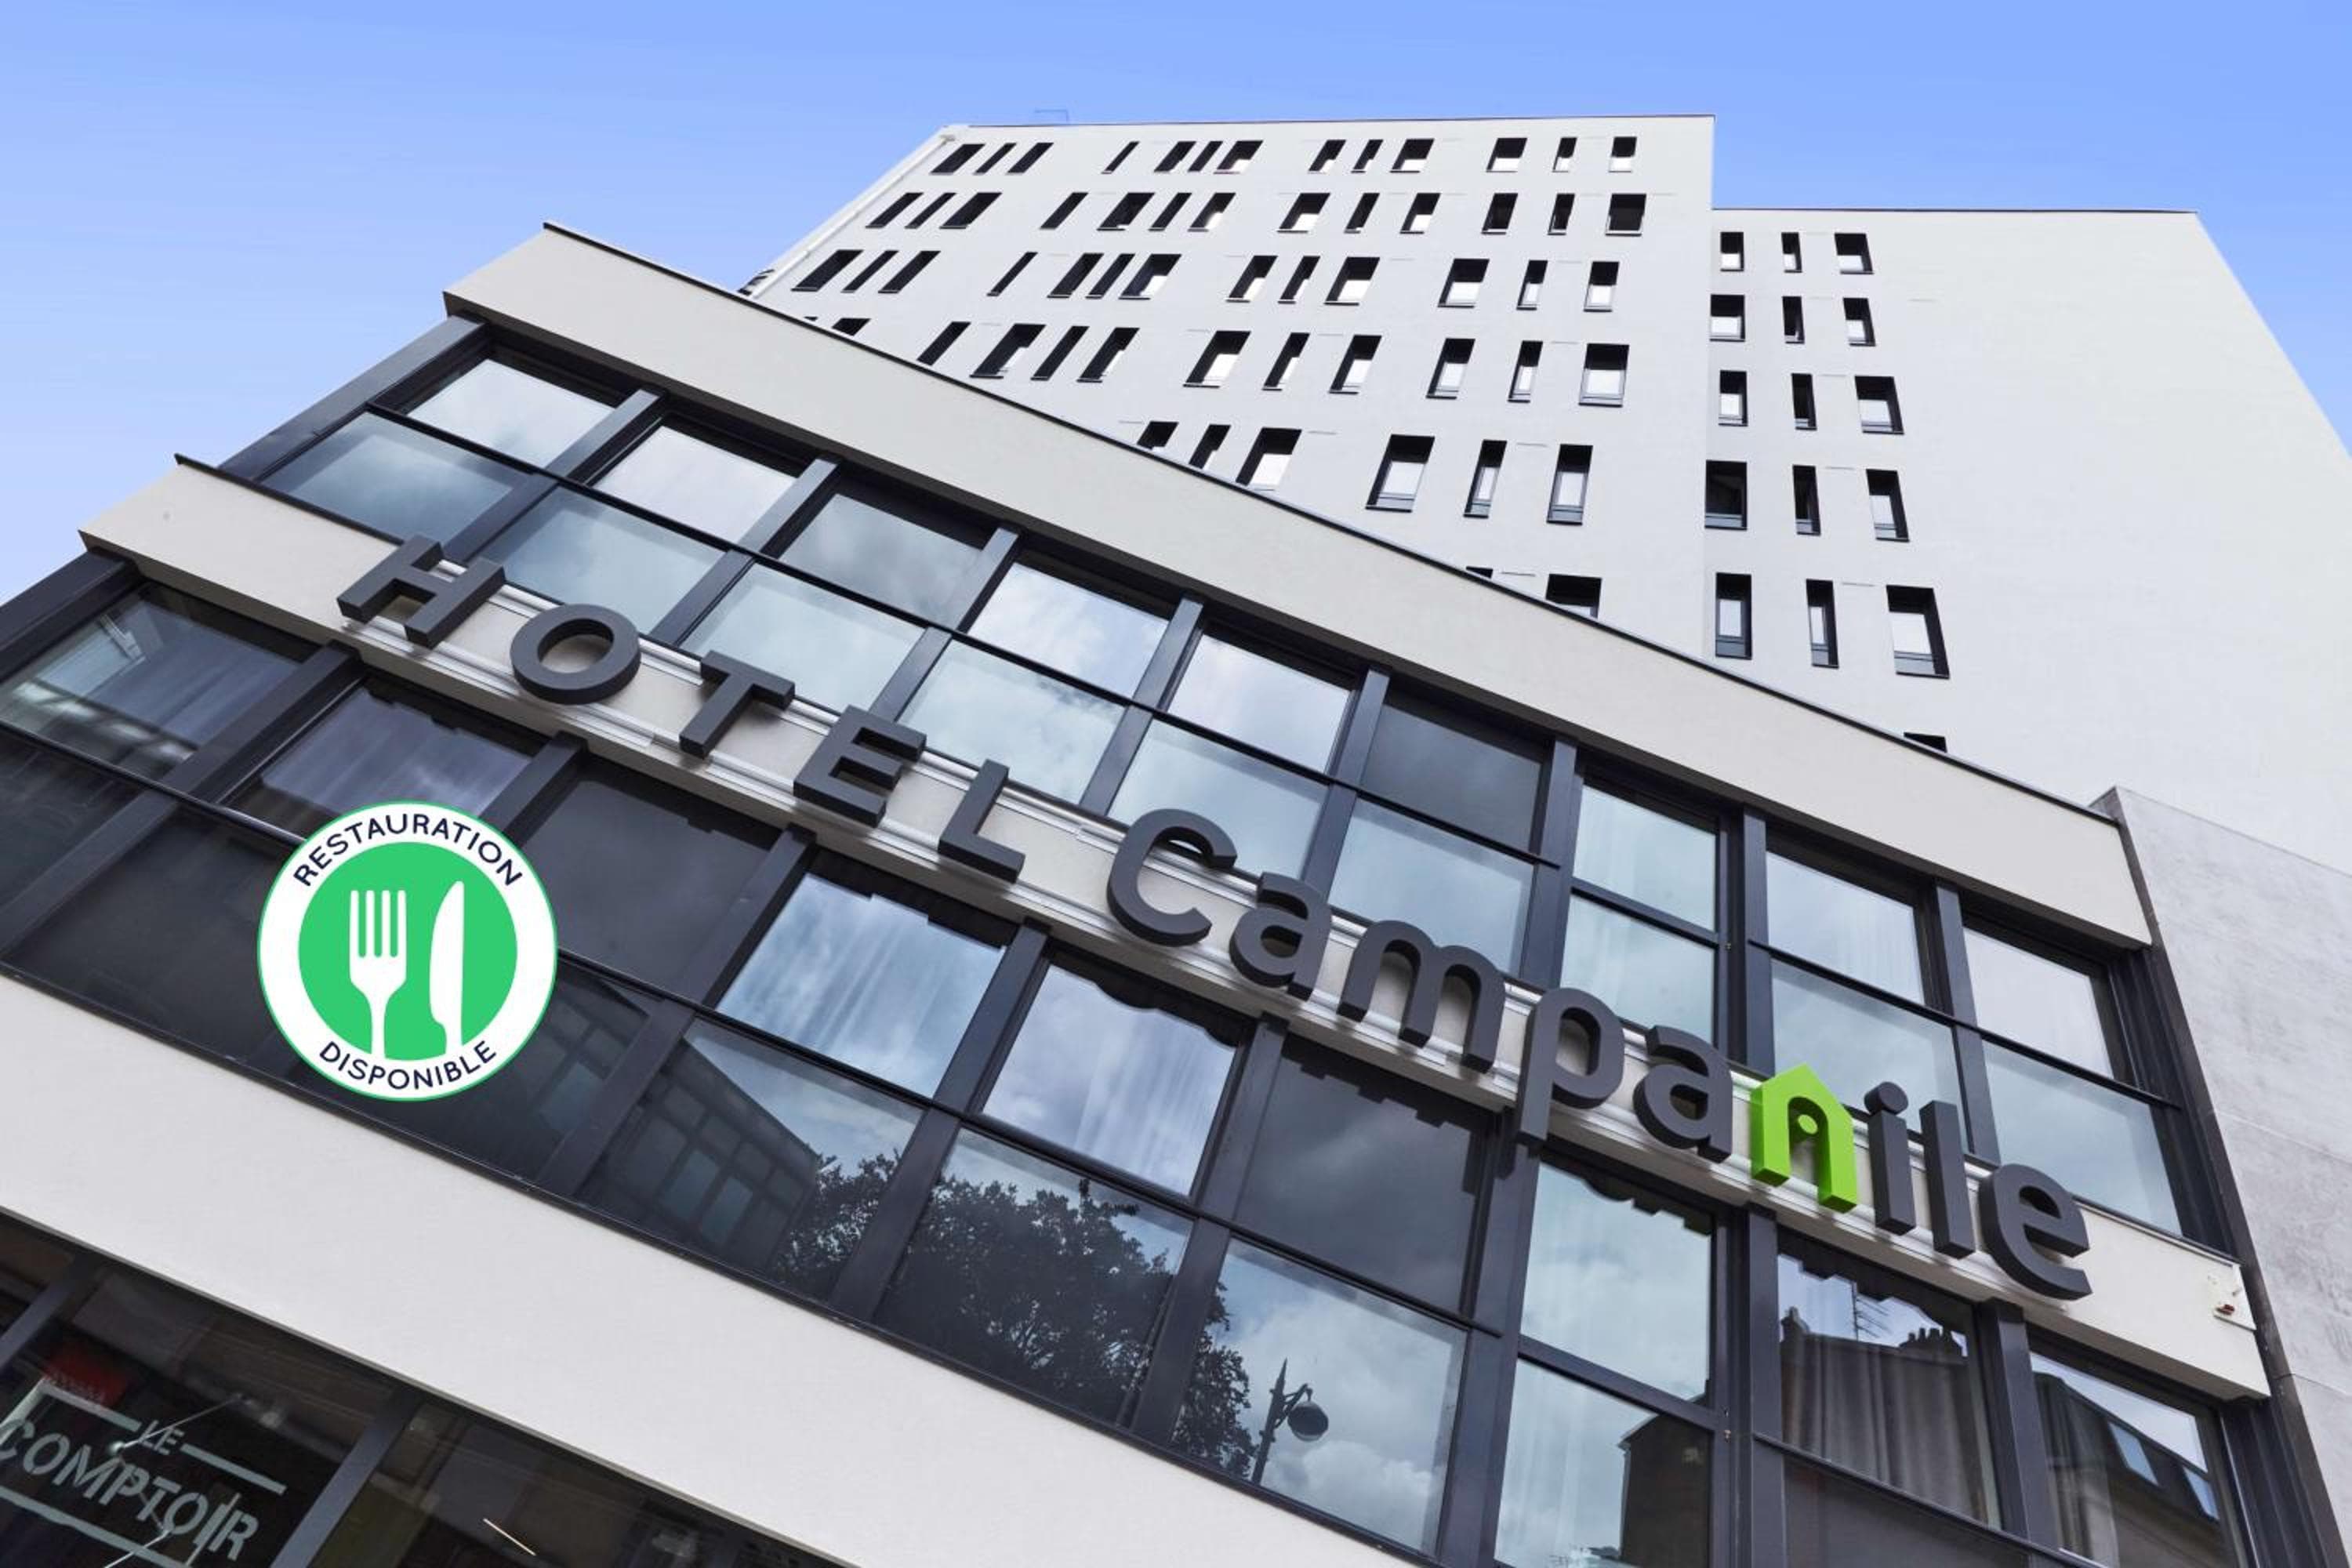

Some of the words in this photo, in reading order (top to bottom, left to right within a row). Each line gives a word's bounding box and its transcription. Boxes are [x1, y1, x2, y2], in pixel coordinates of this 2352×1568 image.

[337, 532, 1025, 884] HOTEL
[1106, 808, 2092, 1300] Campanile
[138, 1420, 185, 1455] LE
